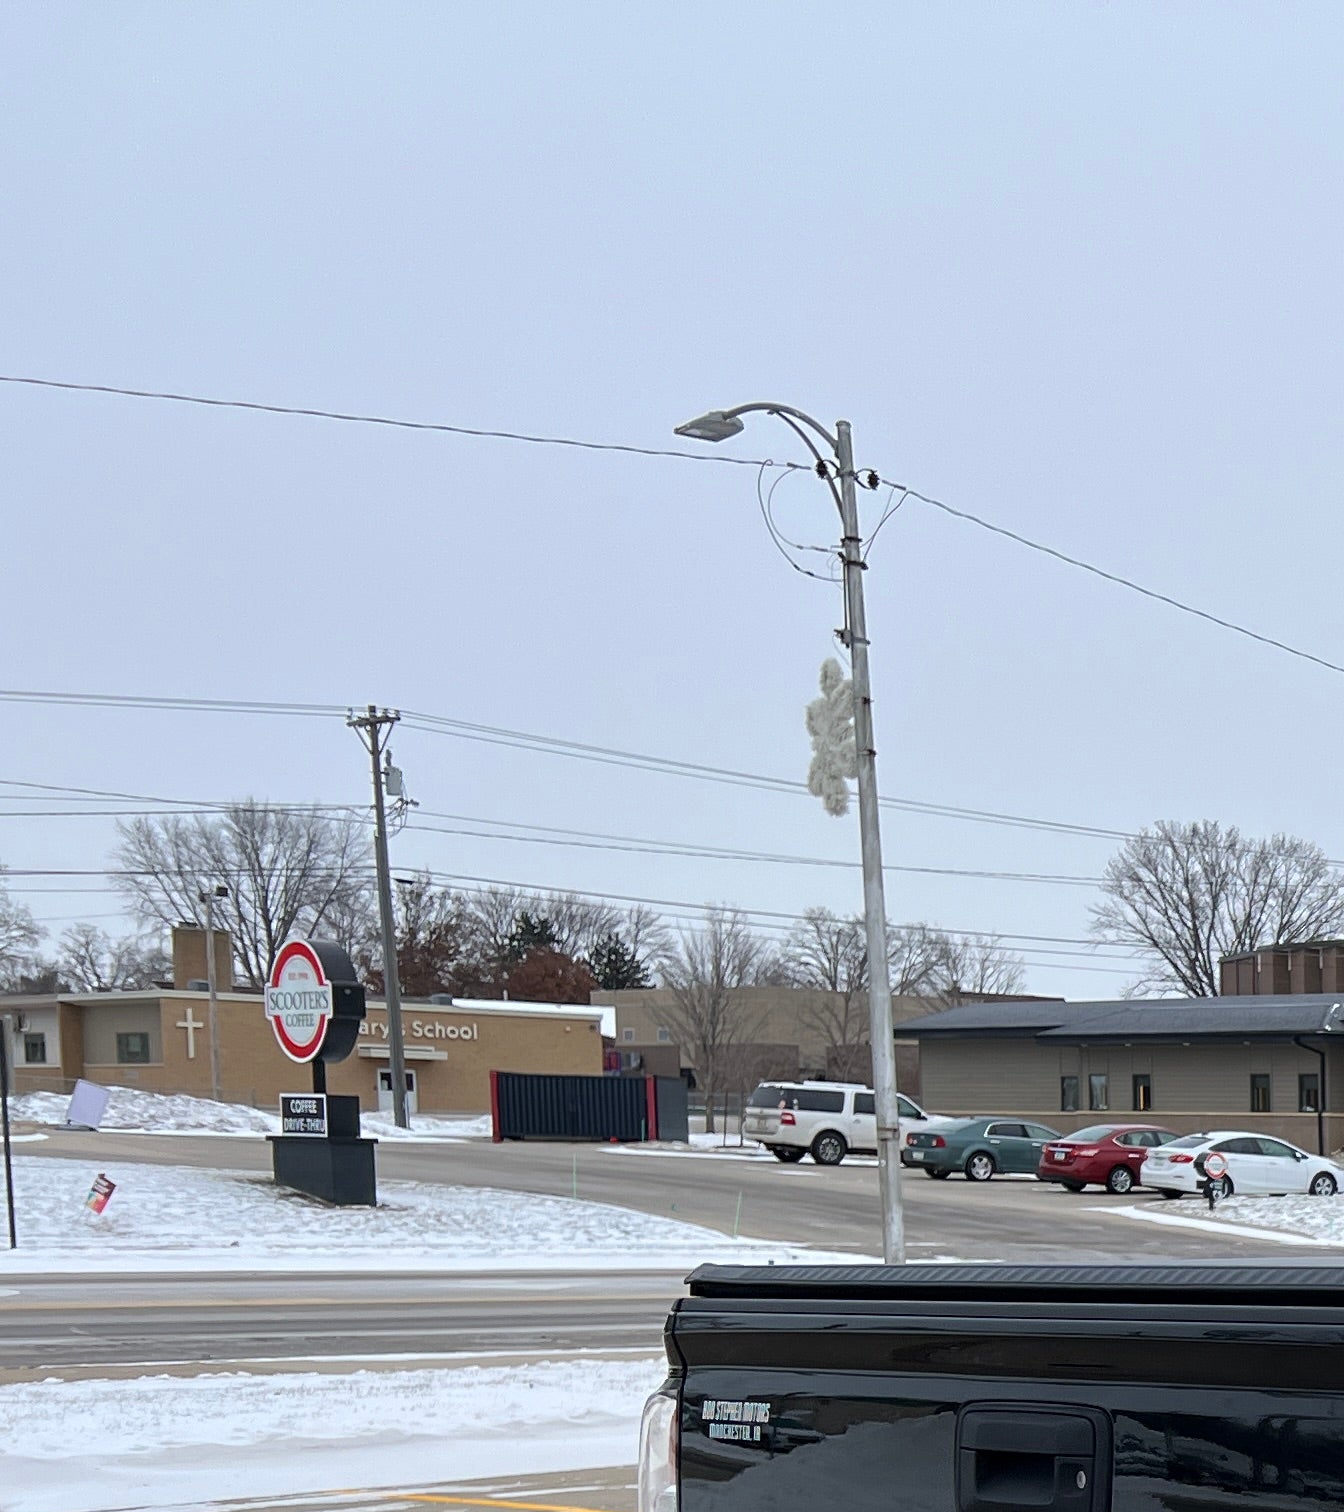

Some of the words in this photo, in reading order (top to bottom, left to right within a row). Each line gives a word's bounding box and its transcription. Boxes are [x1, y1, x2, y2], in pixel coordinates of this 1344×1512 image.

[269, 990, 329, 1011] SCOOTER'S
[285, 1013, 315, 1028] COFFEE
[411, 1020, 479, 1041] School
[290, 1099, 318, 1114] COFFEE
[284, 1117, 326, 1133] DRIVE-THRU
